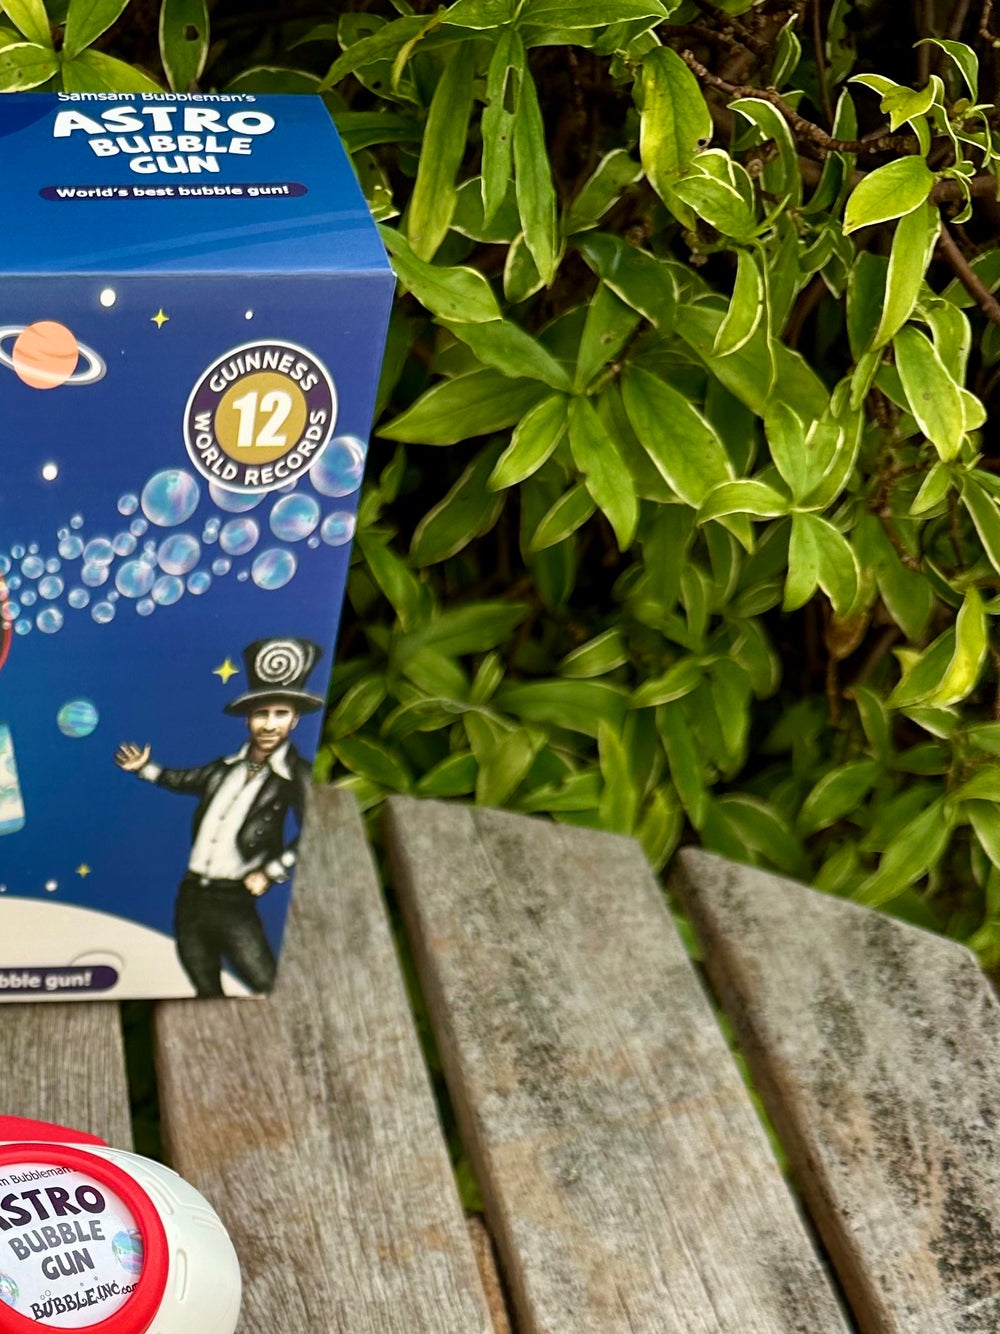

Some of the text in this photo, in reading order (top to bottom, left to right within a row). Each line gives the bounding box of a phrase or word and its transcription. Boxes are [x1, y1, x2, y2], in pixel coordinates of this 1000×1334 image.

[57, 92, 136, 102] Samsam
[53, 106, 276, 138] ASTRO
[88, 135, 253, 157] BUBBLE
[129, 155, 221, 174] GUN
[56, 185, 290, 199] World's best bubble gun!
[208, 350, 320, 394] GUINNESS
[231, 390, 294, 448] 12
[194, 408, 329, 487] WORLD RECORDS
[45, 970, 93, 992] gun!
[9, 1166, 79, 1185] Bubbleman
[7, 1219, 106, 1261] BUBBLE
[41, 1247, 95, 1280] GUN
